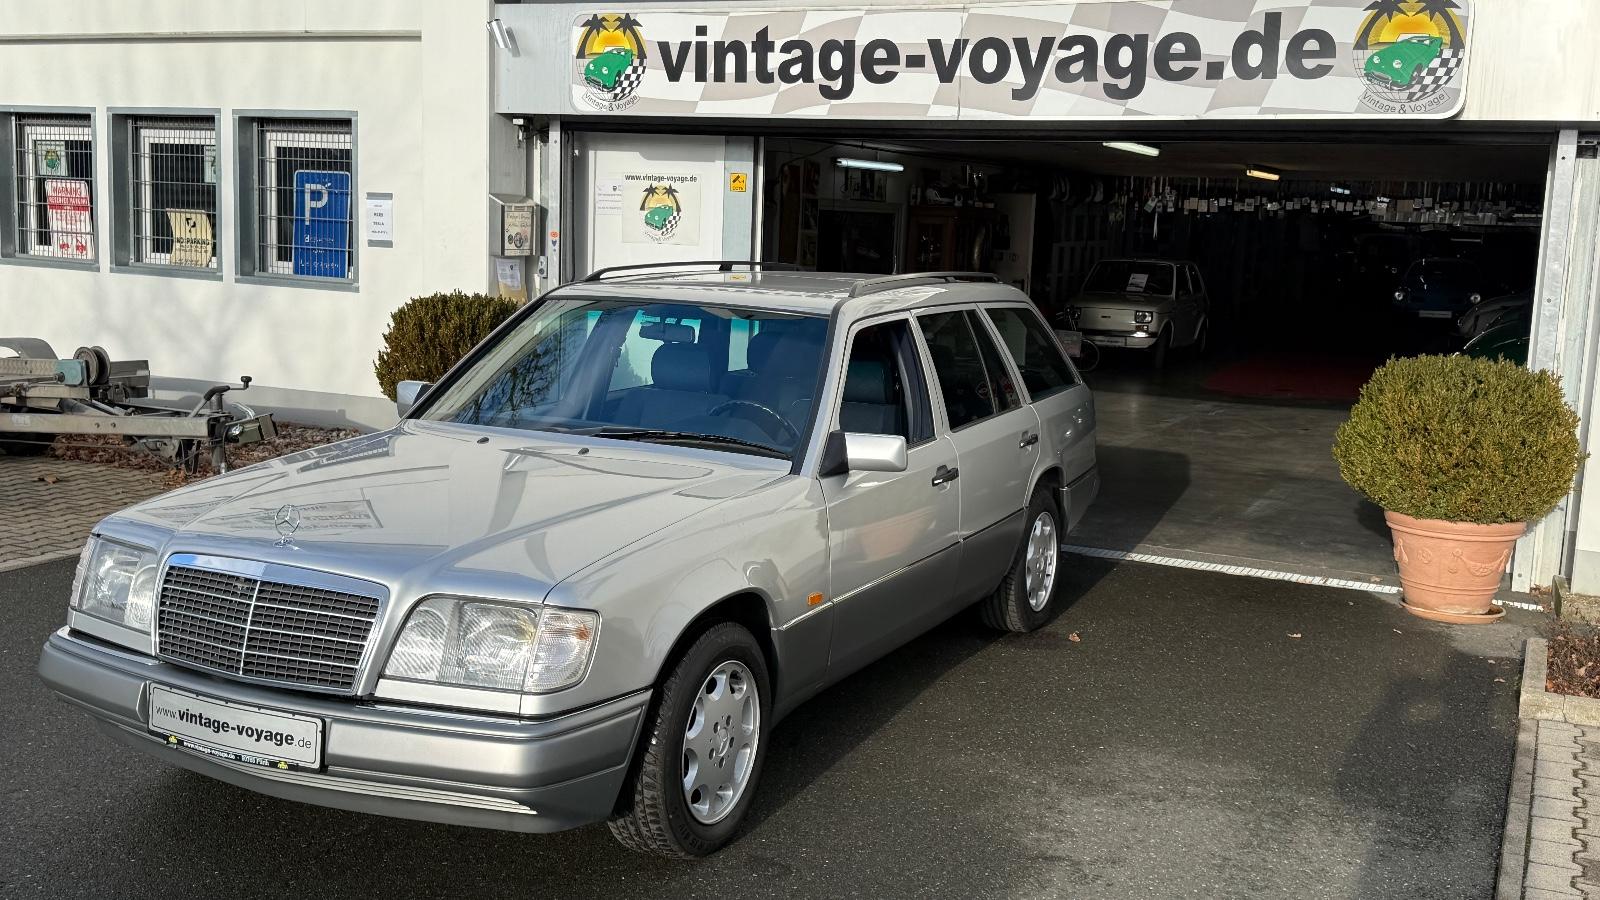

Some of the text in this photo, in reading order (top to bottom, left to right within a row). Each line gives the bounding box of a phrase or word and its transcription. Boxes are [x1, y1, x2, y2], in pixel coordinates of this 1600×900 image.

[657, 12, 1337, 101] vintage-voyage.de
[585, 92, 606, 110] Vintage
[615, 94, 638, 110] Voyage
[1362, 91, 1445, 114] Vintage & Voyage
[624, 174, 698, 184] www.vintage-voyage.de
[155, 705, 312, 749] www.vintage-voyage.de
